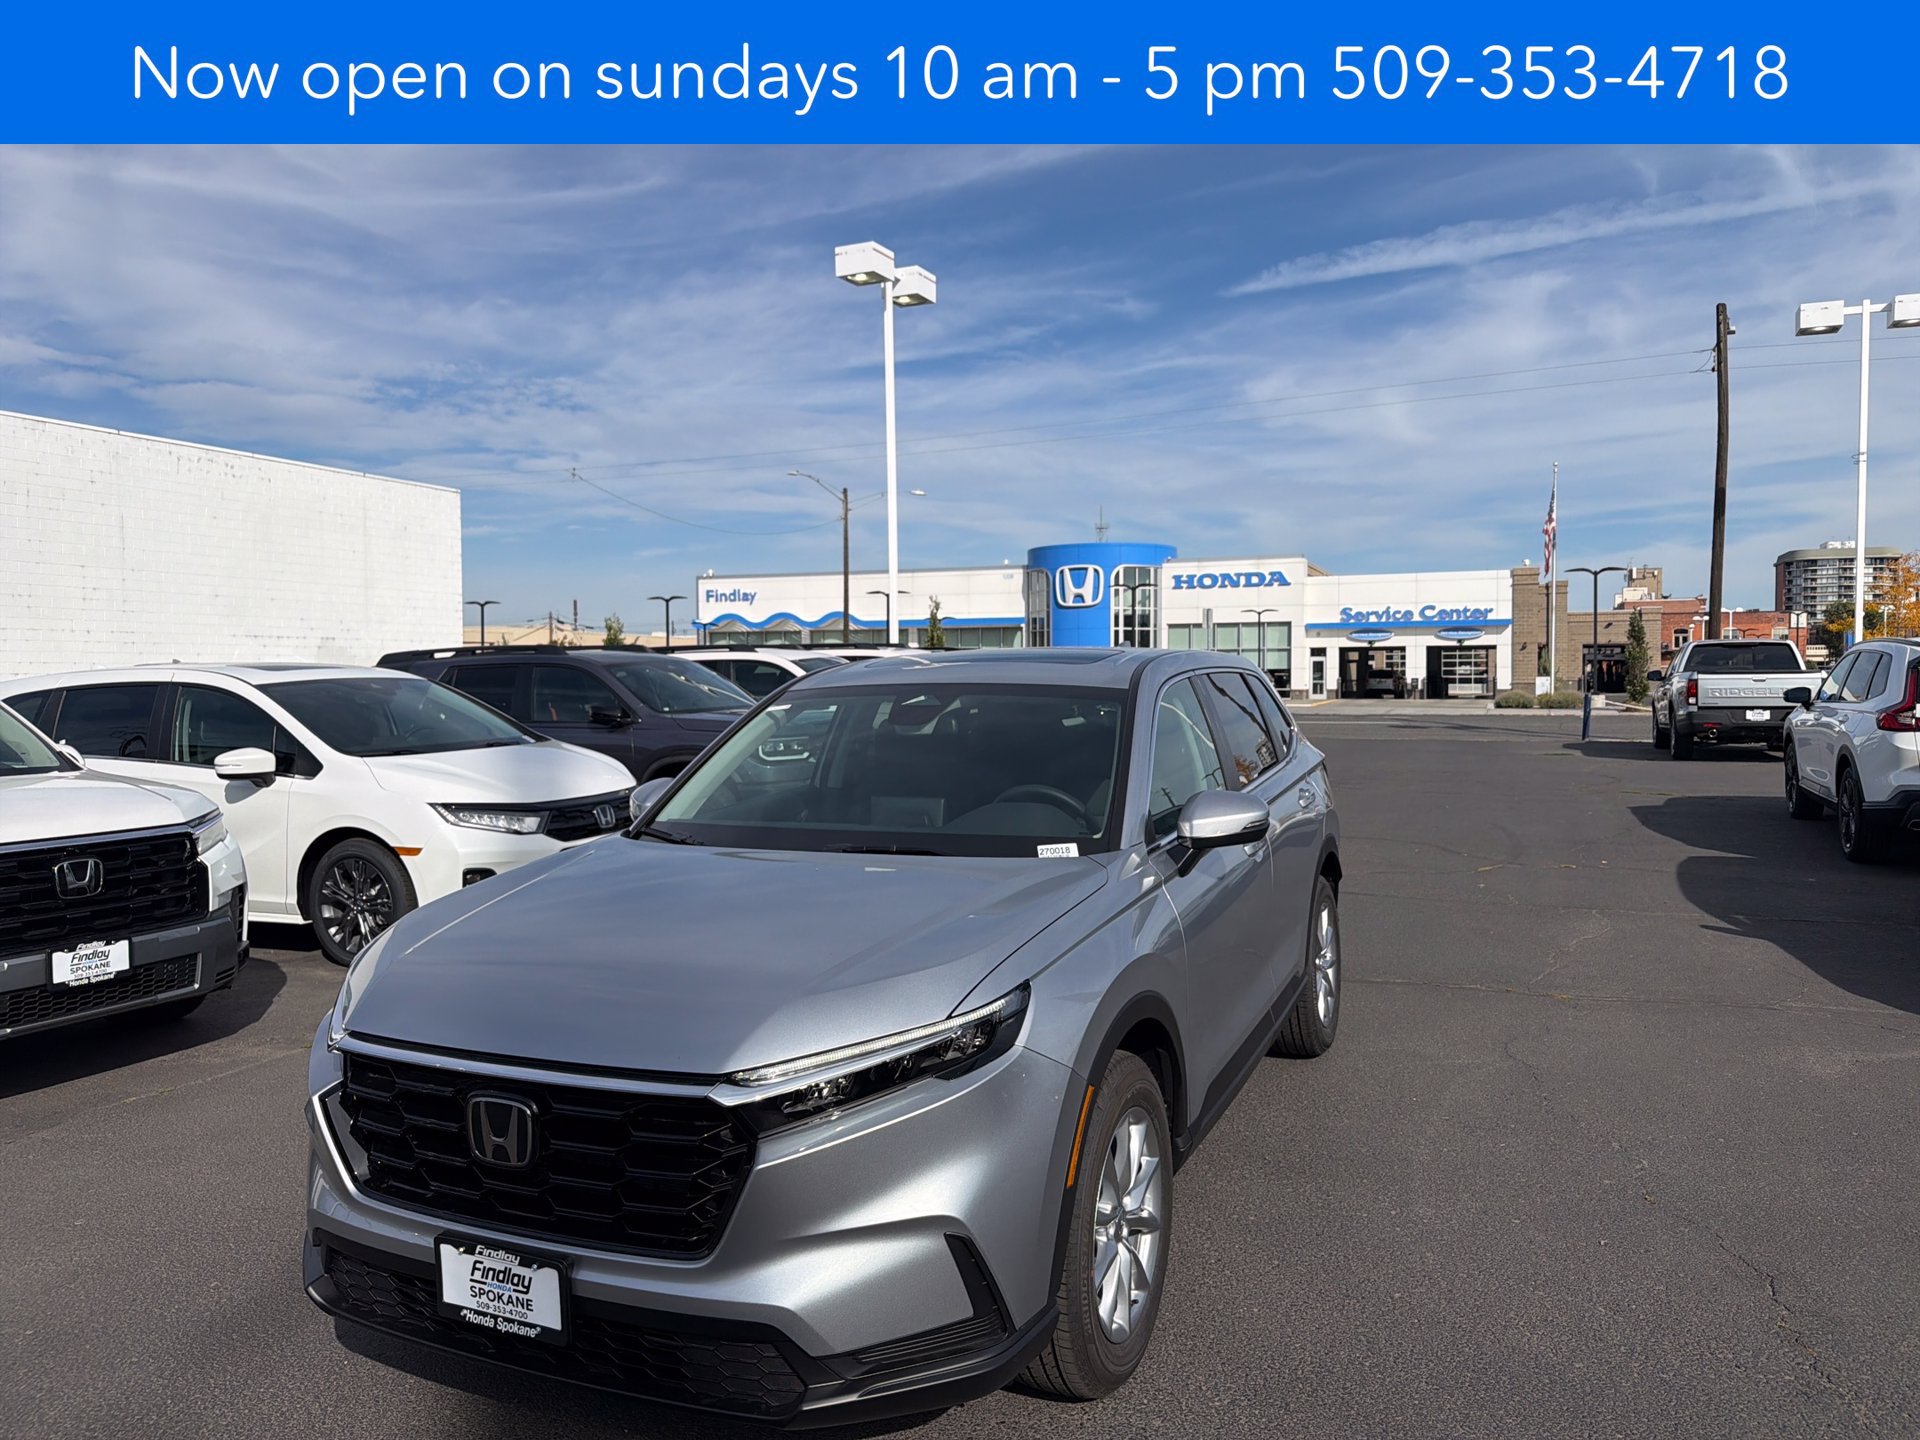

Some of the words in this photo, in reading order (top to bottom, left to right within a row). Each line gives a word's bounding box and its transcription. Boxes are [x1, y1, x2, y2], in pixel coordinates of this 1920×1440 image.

[1172, 571, 1291, 590] HONDA
[706, 588, 757, 605] Findlay
[1340, 606, 1414, 622] Service
[1418, 605, 1494, 621] Center
[1040, 846, 1071, 856] 270018
[70, 949, 111, 967] Findlay
[70, 961, 111, 975] SPOKANE
[475, 1245, 521, 1266] Findlay
[470, 1260, 533, 1295] Findlay
[487, 1282, 513, 1293] HONDA
[470, 1286, 534, 1312] SPOKANE
[476, 1301, 528, 1320] 509-353-4700
